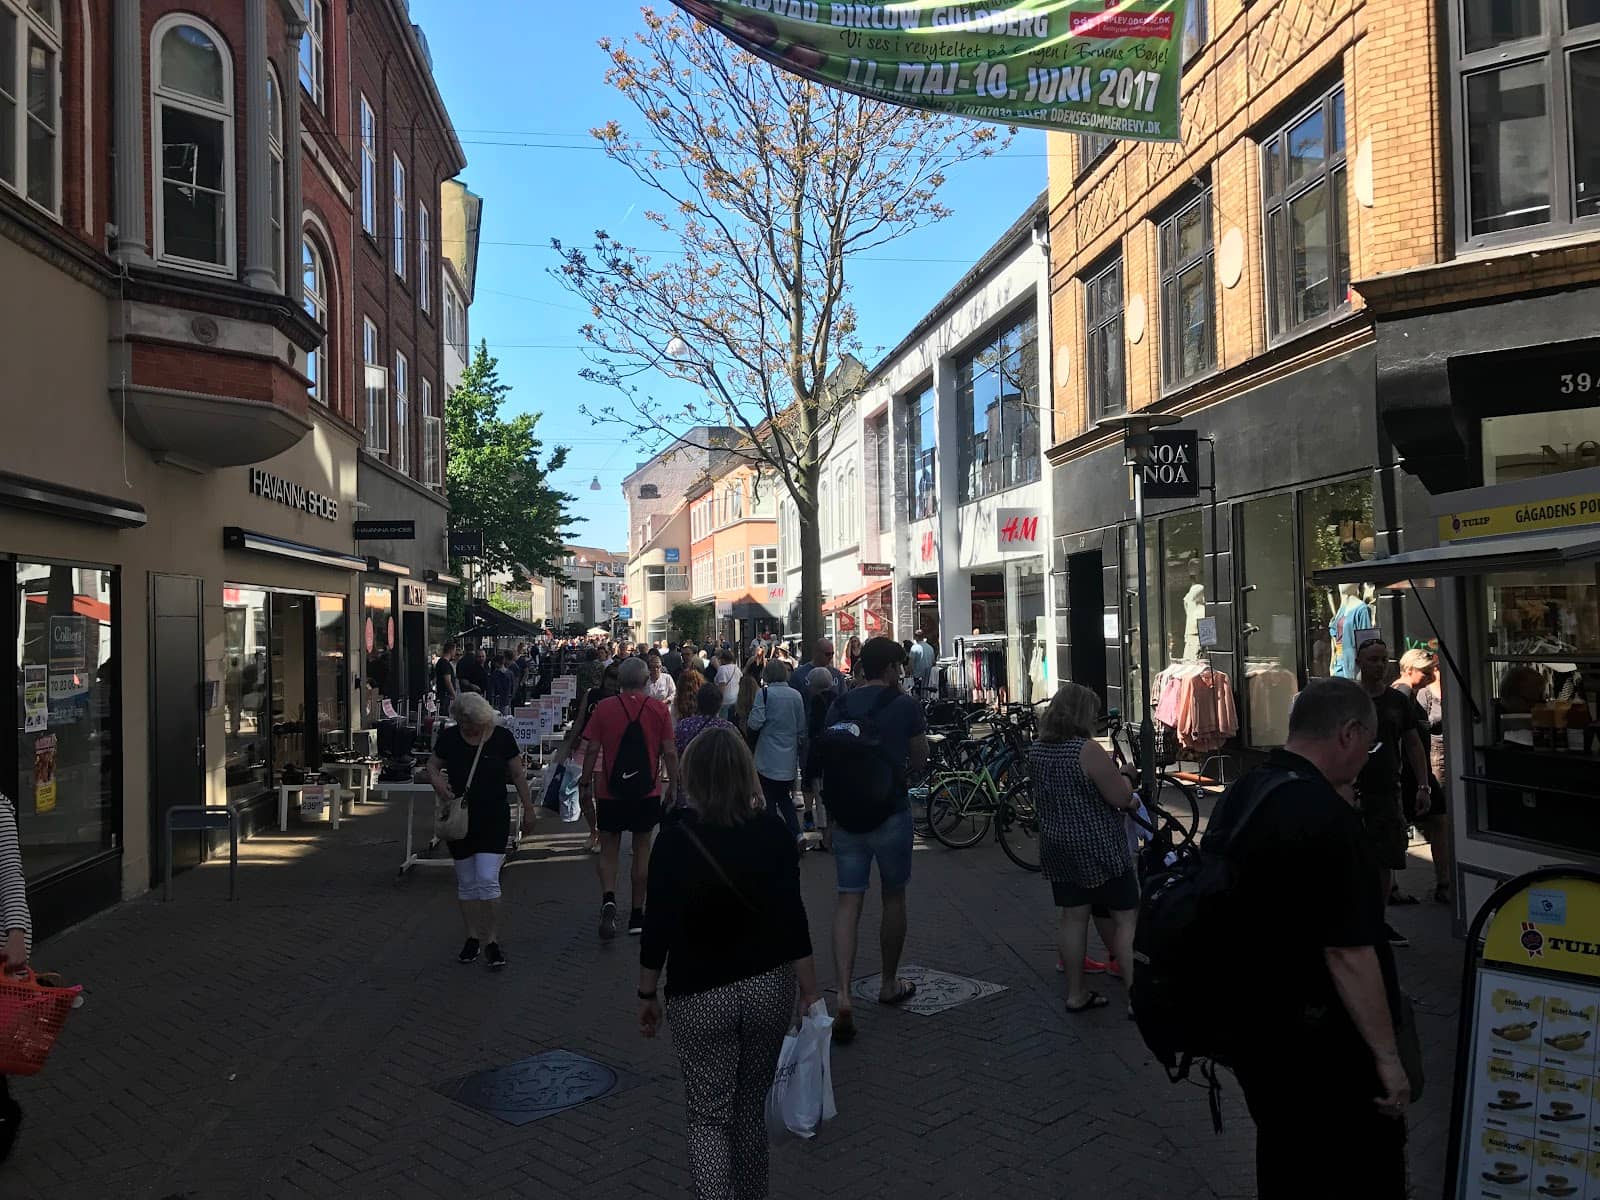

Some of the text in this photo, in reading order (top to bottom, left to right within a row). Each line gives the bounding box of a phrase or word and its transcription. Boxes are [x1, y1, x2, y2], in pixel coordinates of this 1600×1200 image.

[840, 28, 861, 48] Vi
[867, 35, 890, 51] ses
[905, 41, 982, 62] revyteltet
[1073, 42, 1124, 61] Fruens
[846, 58, 885, 88] 11.
[1024, 66, 1092, 104] JUNI
[1099, 68, 1161, 112] 2017
[1050, 107, 1161, 135] ODENSESOMMERREVY.DK
[1143, 465, 1192, 485] NOA
[252, 467, 338, 521] HAVANNA SHOES
[1001, 516, 1039, 542] H&M
[1462, 516, 1491, 528] TULIP
